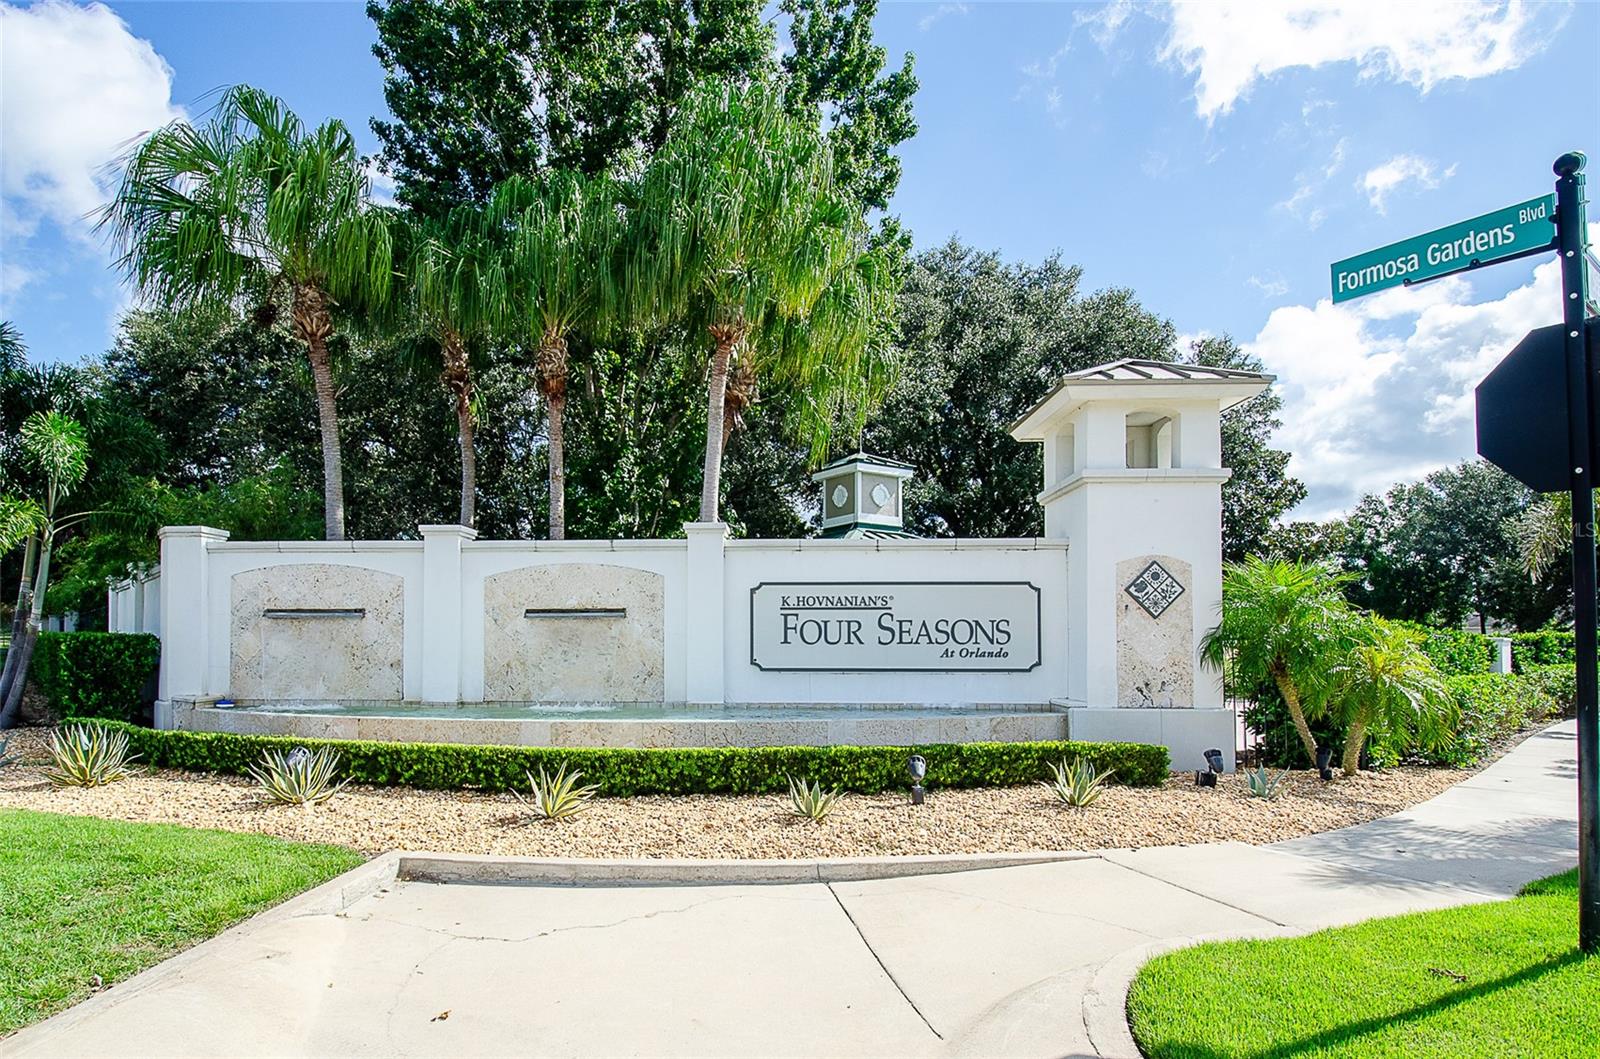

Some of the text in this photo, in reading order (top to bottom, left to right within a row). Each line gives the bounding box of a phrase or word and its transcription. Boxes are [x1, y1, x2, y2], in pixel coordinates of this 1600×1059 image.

[1338, 202, 1547, 293] Formosa Gardens Blvd
[780, 612, 1012, 646] FOUR SEASONS
[940, 646, 1010, 659] At Orlando
